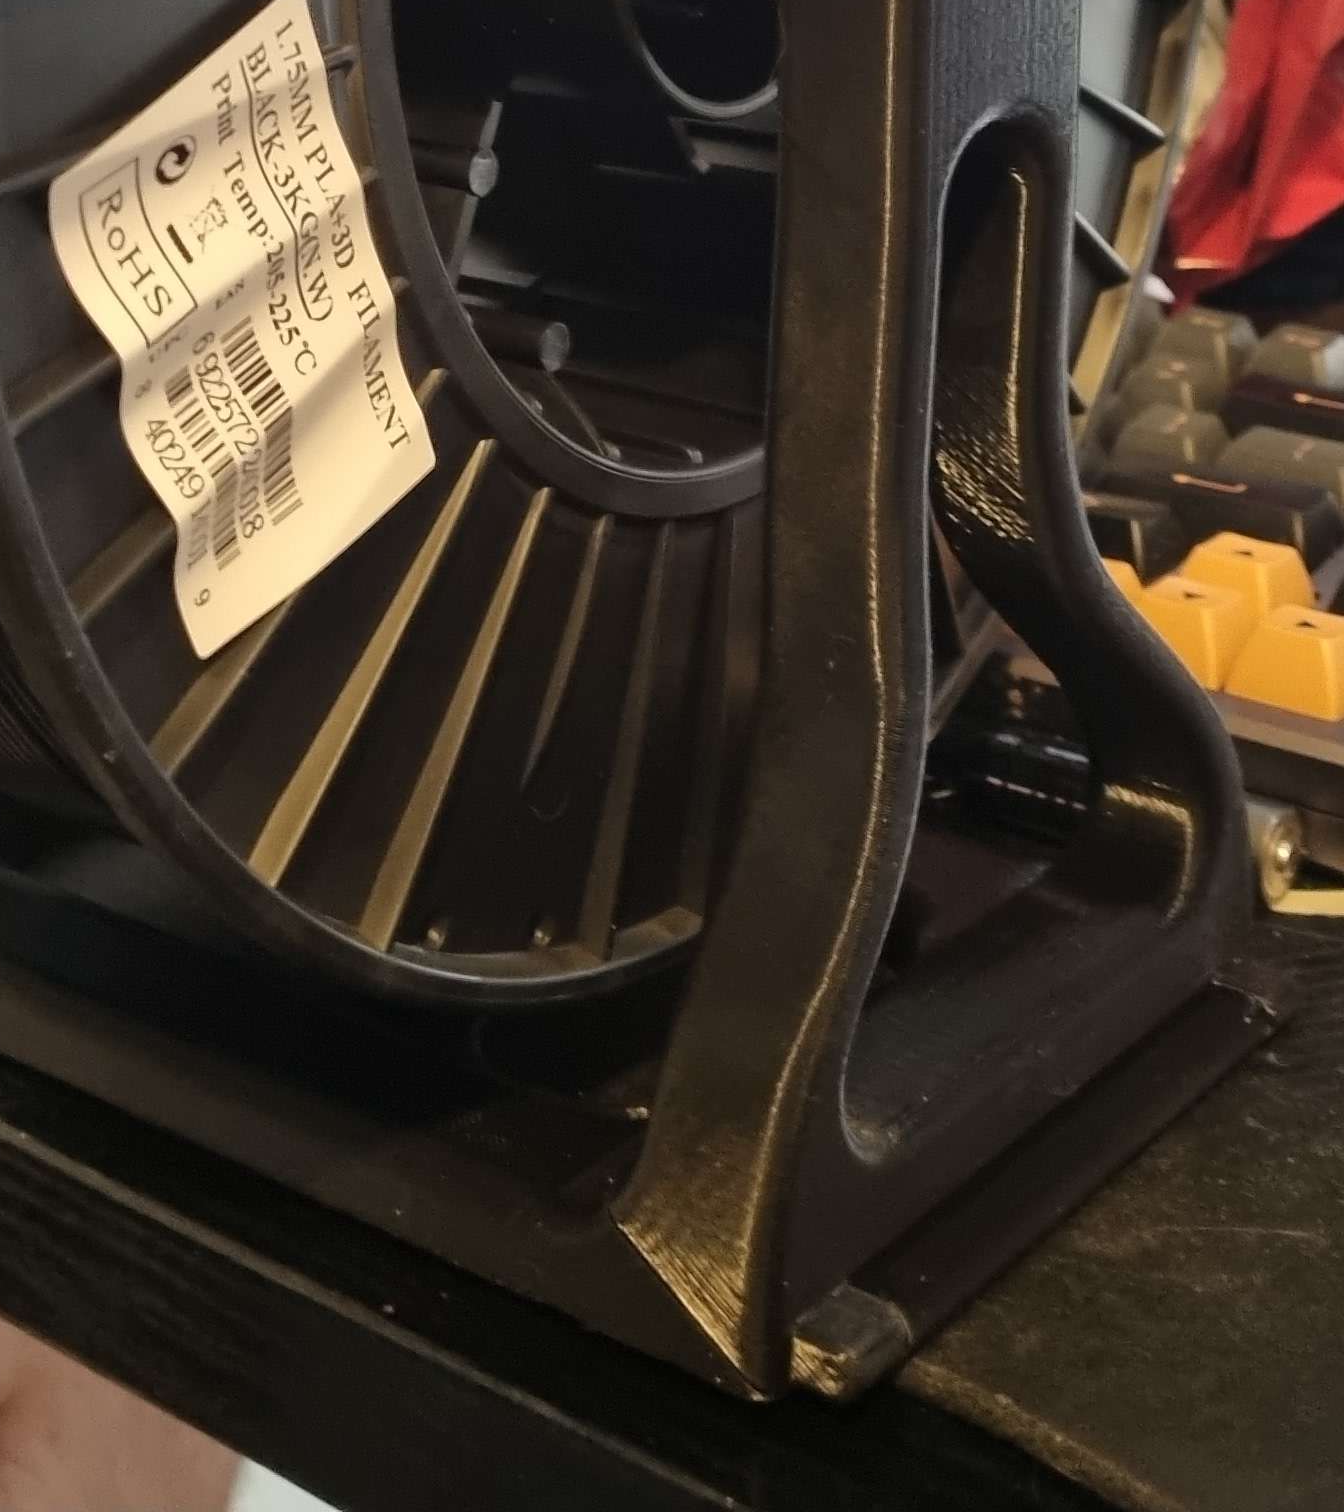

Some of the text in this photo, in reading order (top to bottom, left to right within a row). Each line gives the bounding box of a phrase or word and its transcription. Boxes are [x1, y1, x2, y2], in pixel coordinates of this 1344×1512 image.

[212, 70, 238, 147] Print
[97, 185, 174, 318] RoHS
[274, 18, 320, 143] 1.75MM
[346, 278, 411, 452] FILAMENT
